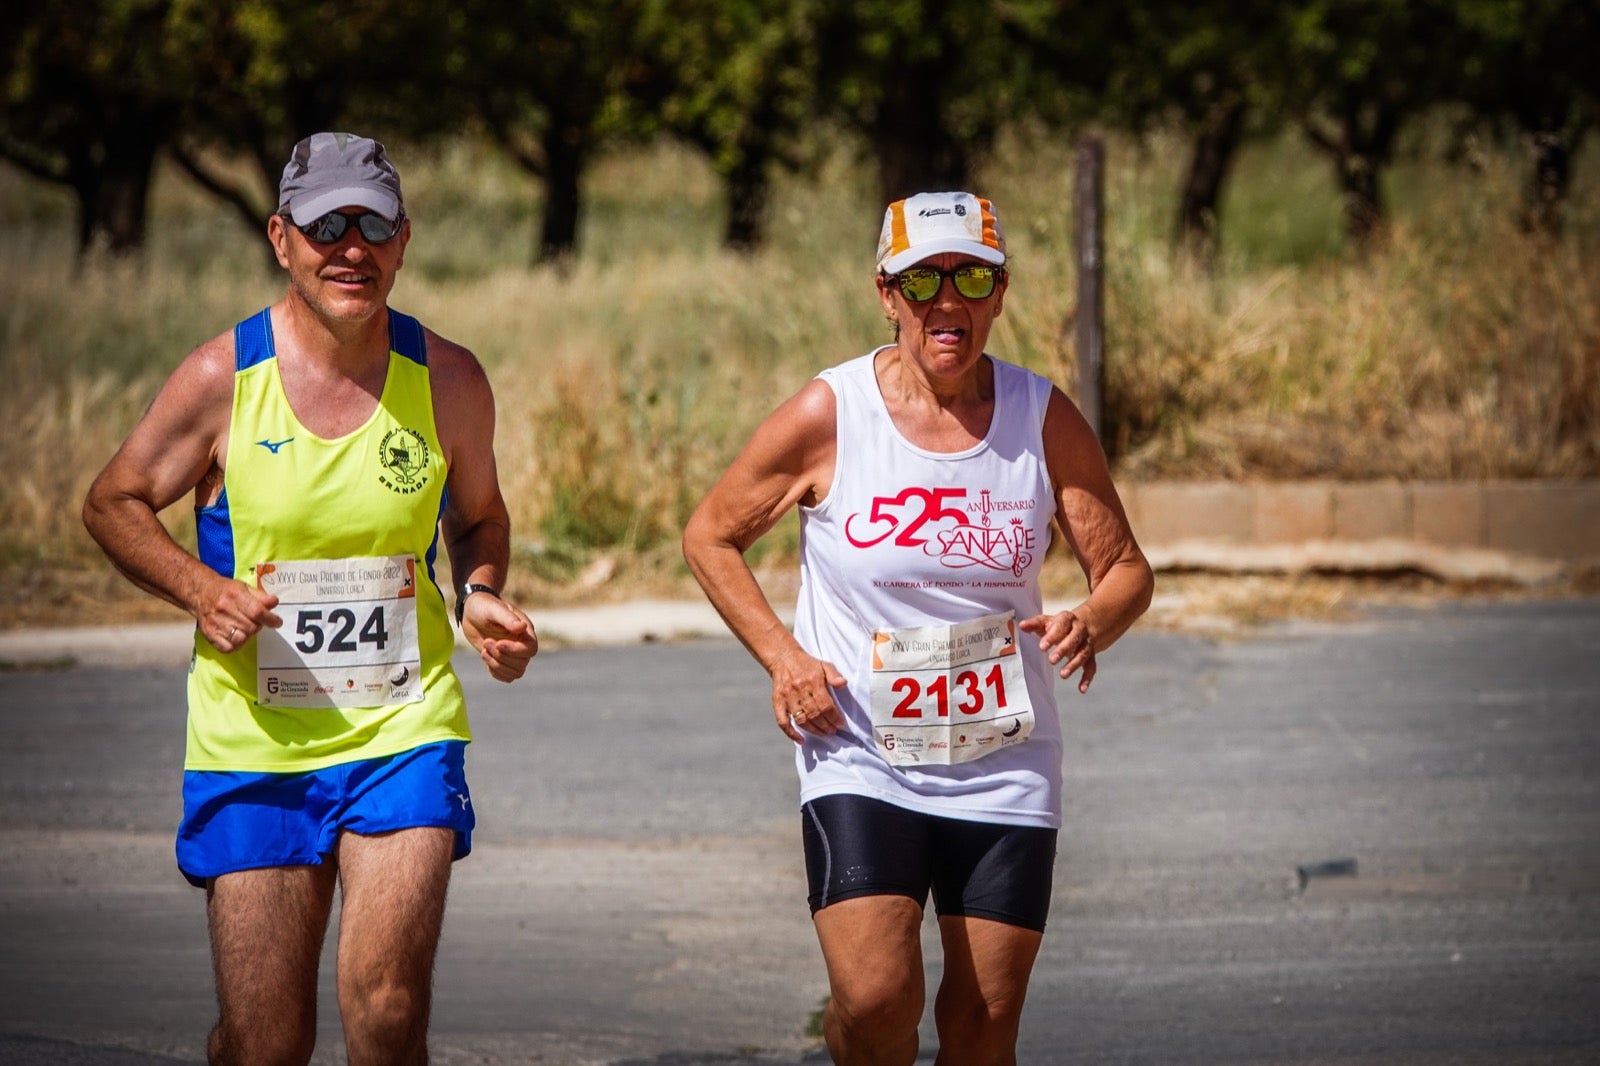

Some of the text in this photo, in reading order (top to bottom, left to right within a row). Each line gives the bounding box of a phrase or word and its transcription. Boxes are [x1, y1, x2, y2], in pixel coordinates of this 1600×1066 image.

[379, 475, 427, 494] GRANADA
[845, 487, 970, 549] 525
[383, 566, 400, 579] 2022
[883, 581, 921, 589] CARRERA
[295, 606, 389, 654] 524
[984, 626, 1000, 641] 2022
[891, 664, 1007, 718] 2131
